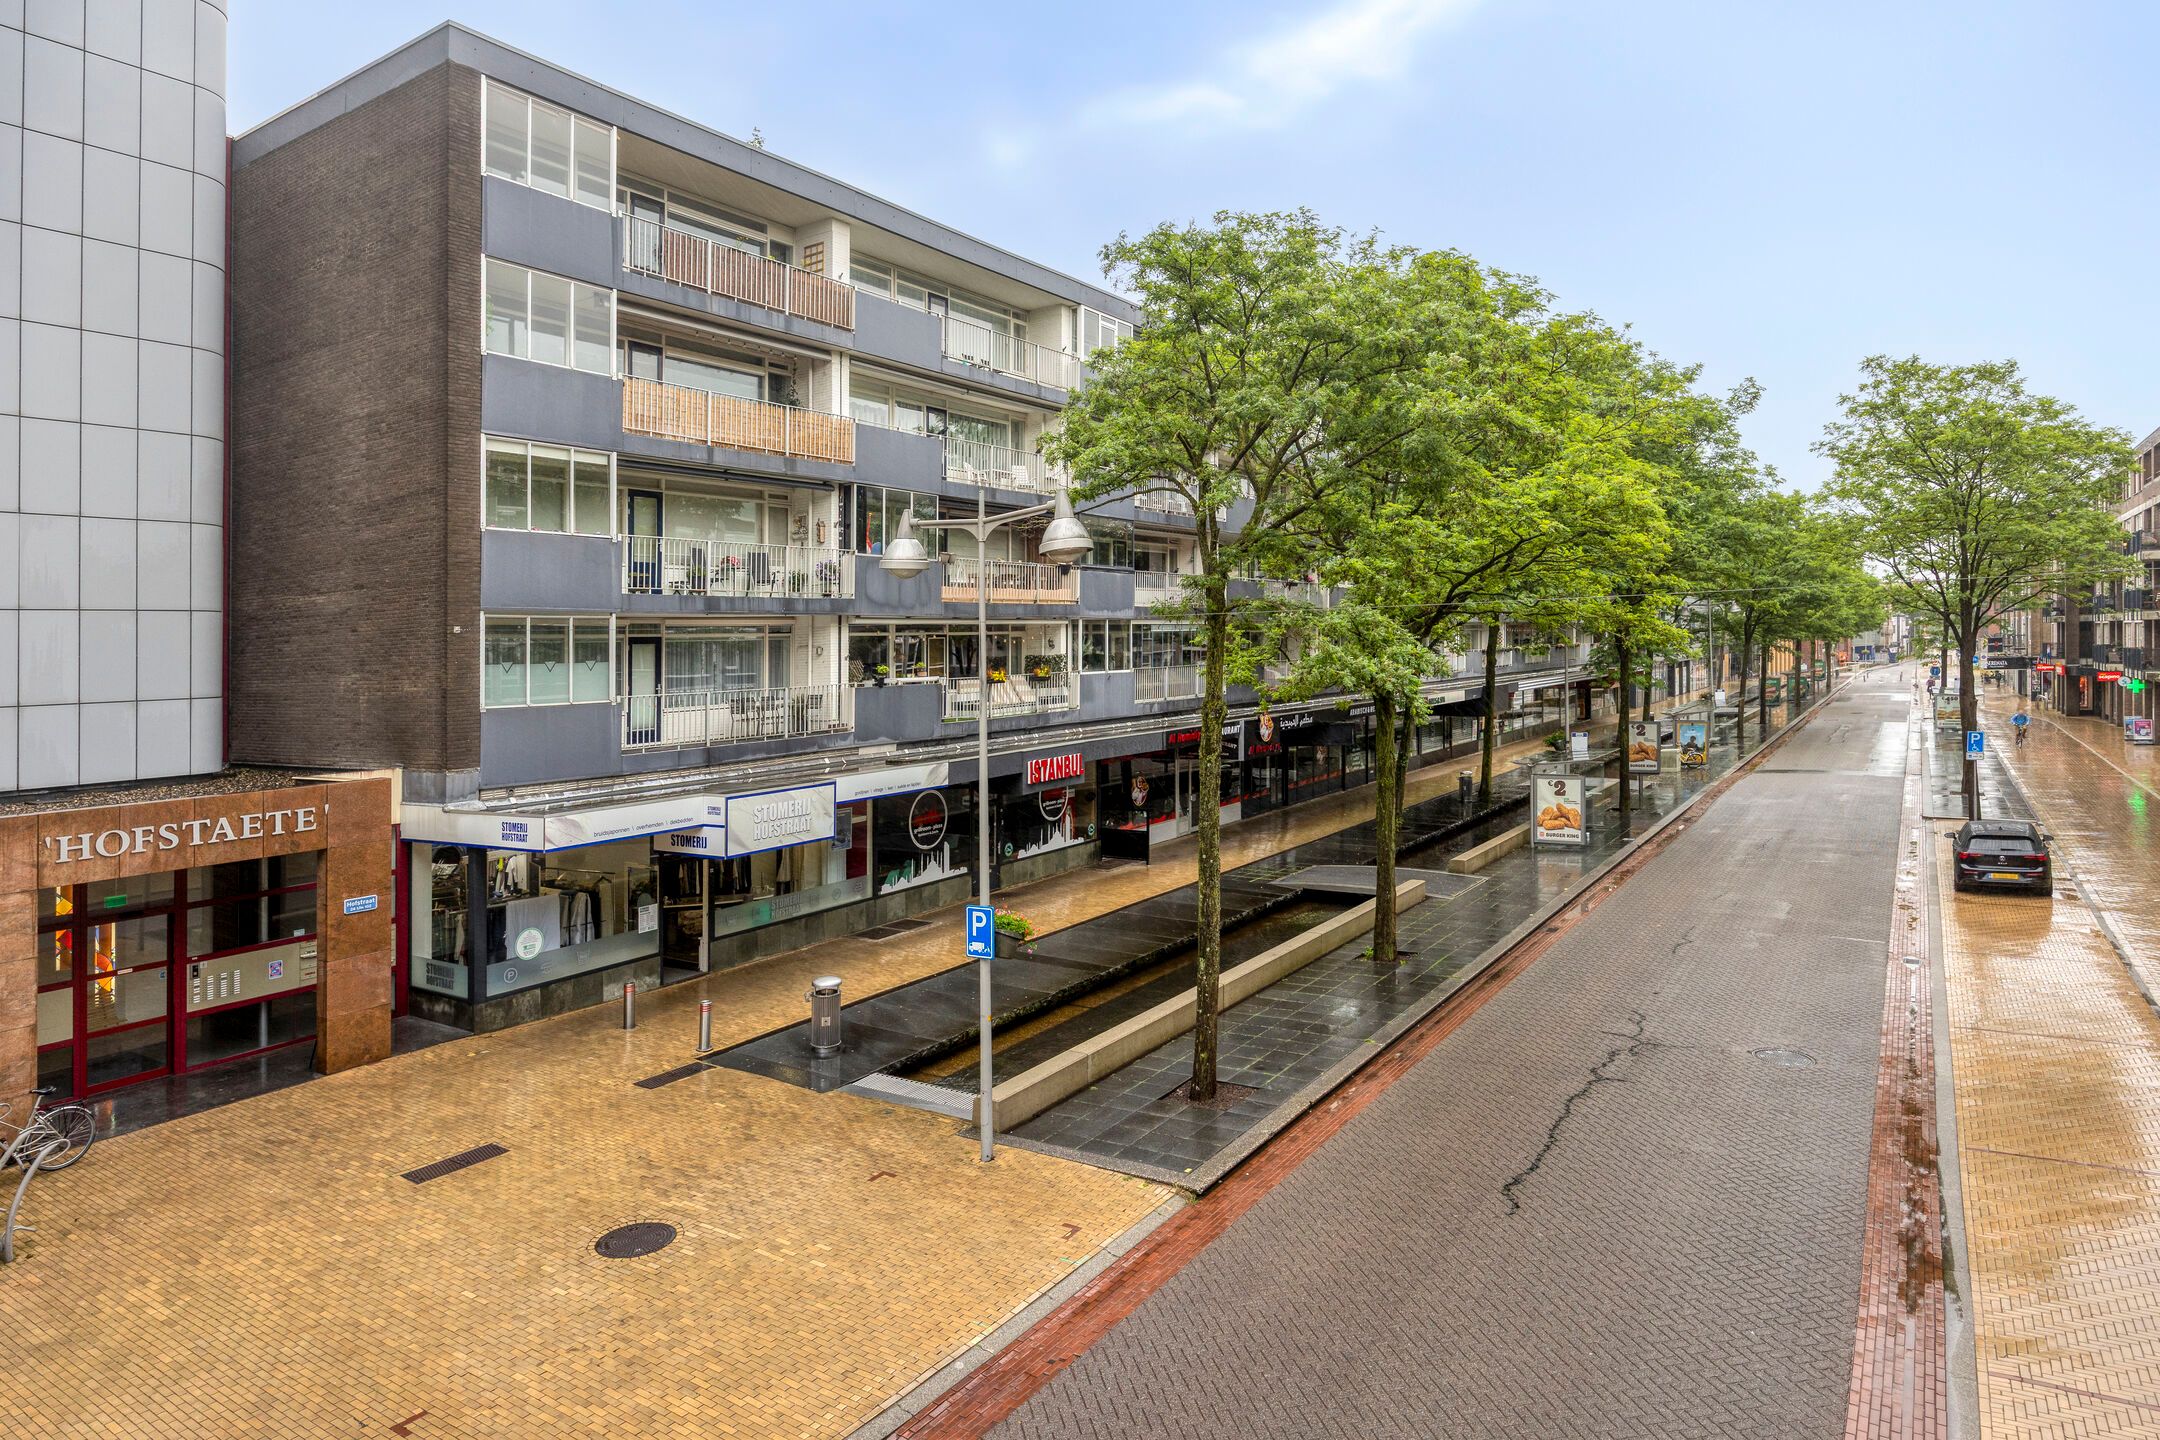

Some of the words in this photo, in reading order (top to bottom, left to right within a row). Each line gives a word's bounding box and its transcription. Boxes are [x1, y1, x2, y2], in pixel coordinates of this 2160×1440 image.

[1972, 733, 1980, 743] P
[1027, 752, 1085, 785] ISTANBUL
[753, 798, 812, 824] STOMERIJ
[501, 821, 528, 833] STOMERIJ
[753, 816, 812, 841] HOFSTRAAT
[501, 832, 528, 843] HOFSTRAAT
[670, 834, 708, 849] STOMERIJ
[346, 897, 375, 908] Hofstraat
[972, 911, 987, 936] P
